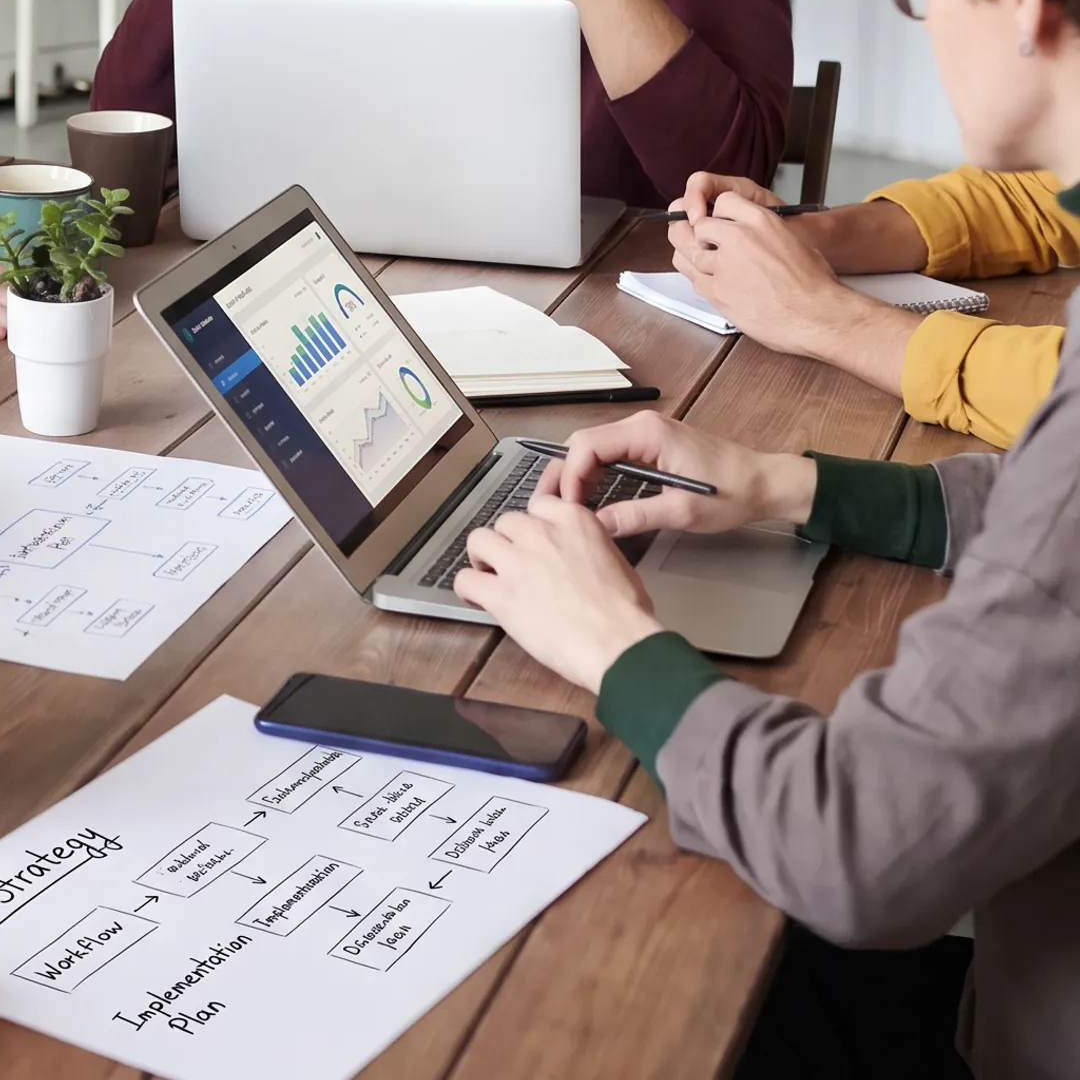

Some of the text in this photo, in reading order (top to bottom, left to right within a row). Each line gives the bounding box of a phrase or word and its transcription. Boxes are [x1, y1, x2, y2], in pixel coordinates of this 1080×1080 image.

[33, 920, 124, 981] Workflow
[111, 933, 254, 1032] Implementation
[167, 1000, 227, 1036] Plan
